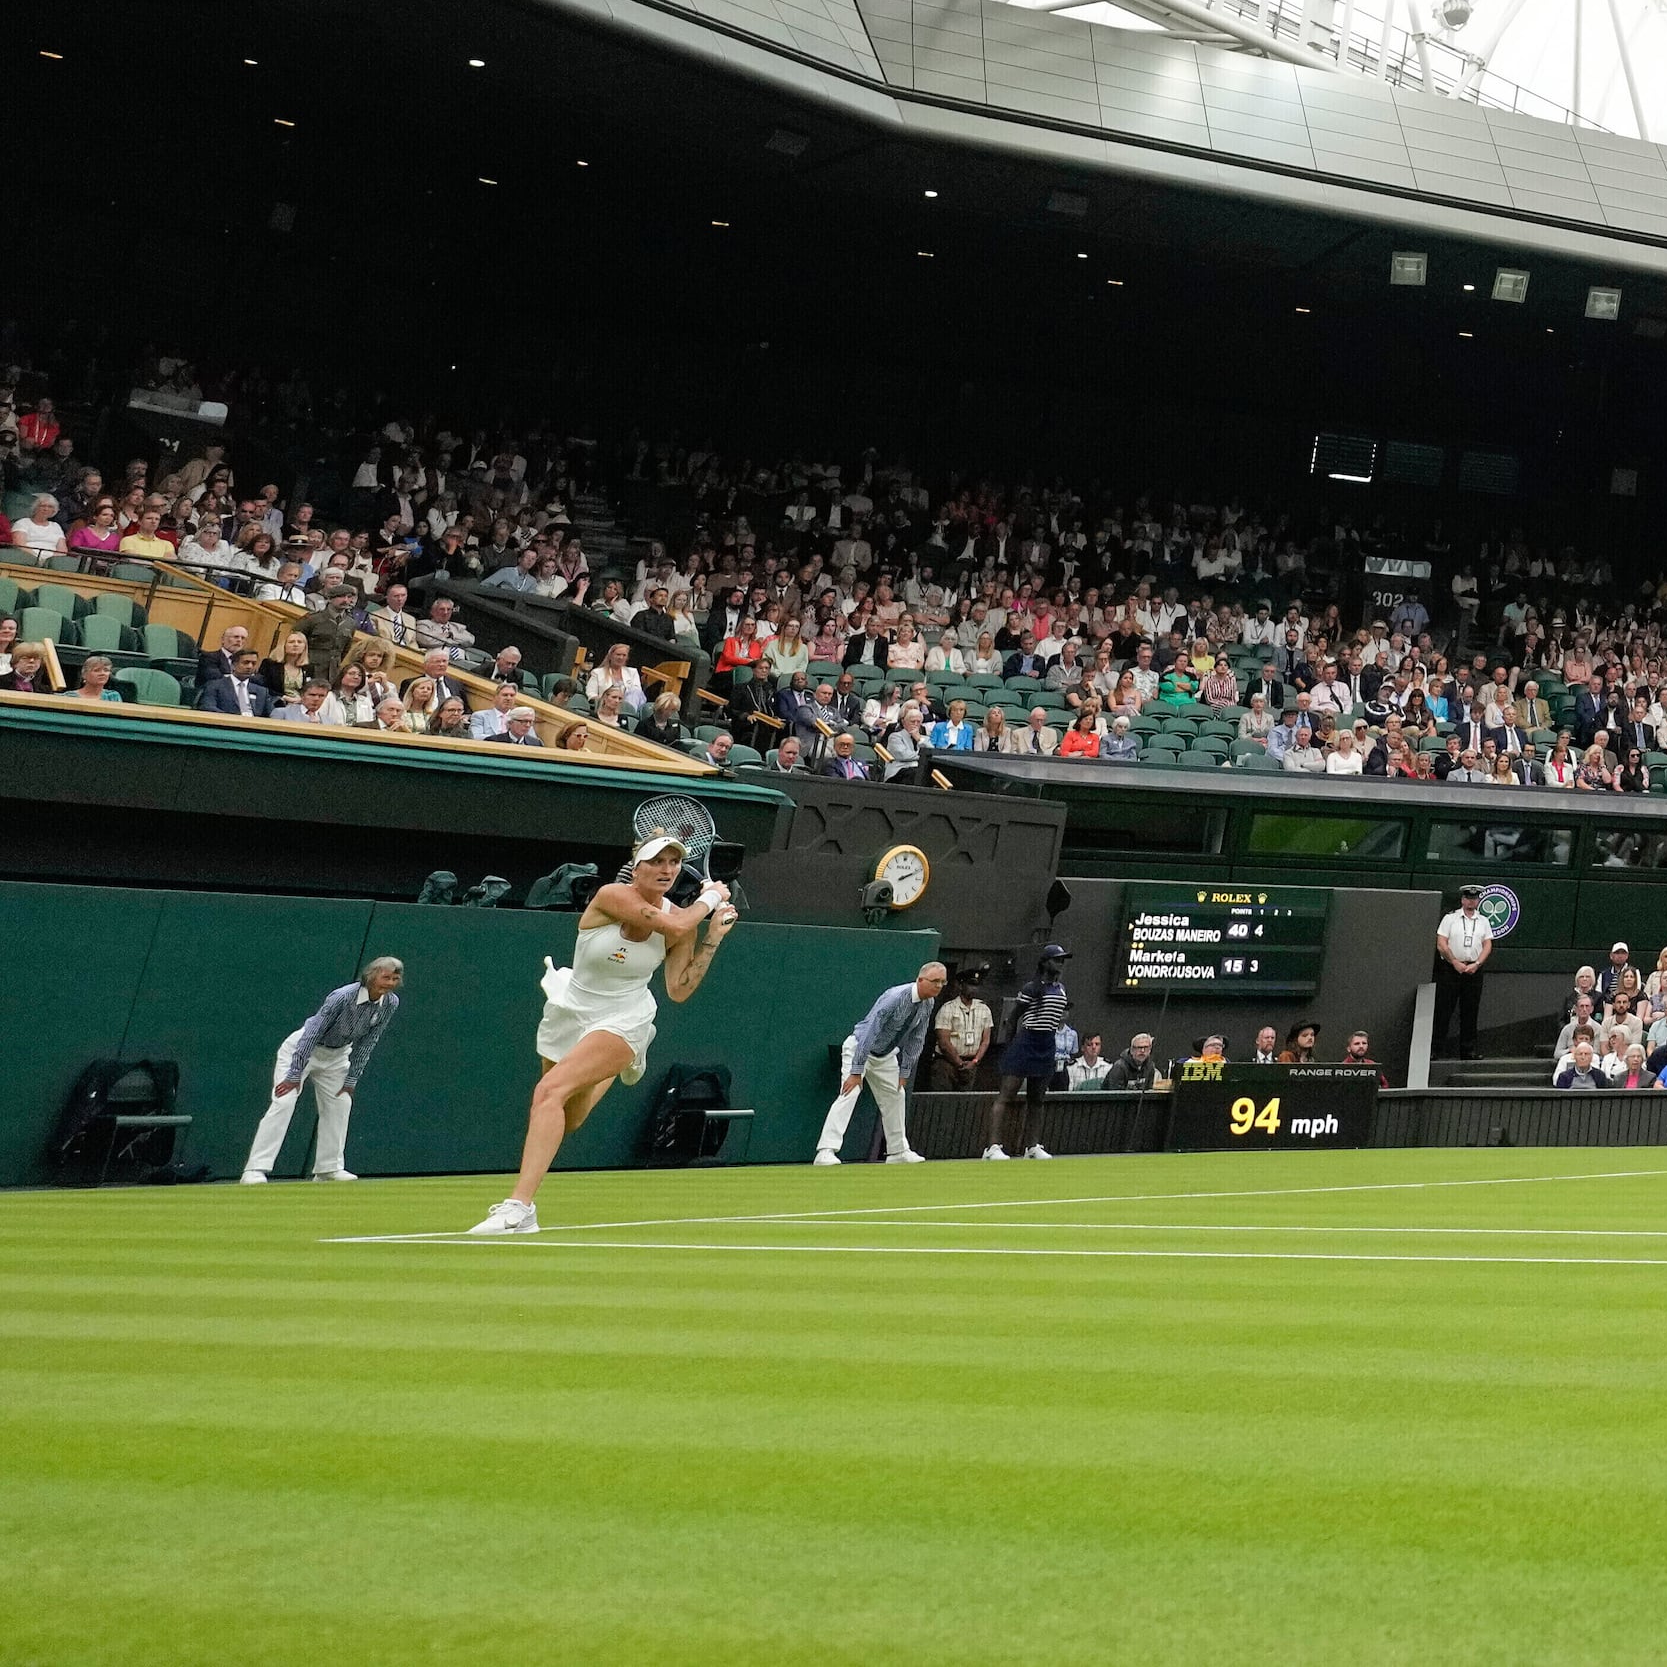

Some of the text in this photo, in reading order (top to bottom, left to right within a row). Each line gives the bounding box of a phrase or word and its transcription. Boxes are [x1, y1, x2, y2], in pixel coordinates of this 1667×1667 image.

[1372, 591, 1404, 608] 302
[1211, 893, 1252, 904] ROLEX
[1135, 912, 1190, 927] Jessica
[1132, 924, 1264, 943] BOUZAS MANEIRO 40 4
[1127, 959, 1259, 980] VONDROUSOVA 15 3
[1181, 1062, 1225, 1081] IBM
[1289, 1068, 1377, 1077] RANGE ROVER
[1230, 1097, 1339, 1138] 94 mph
